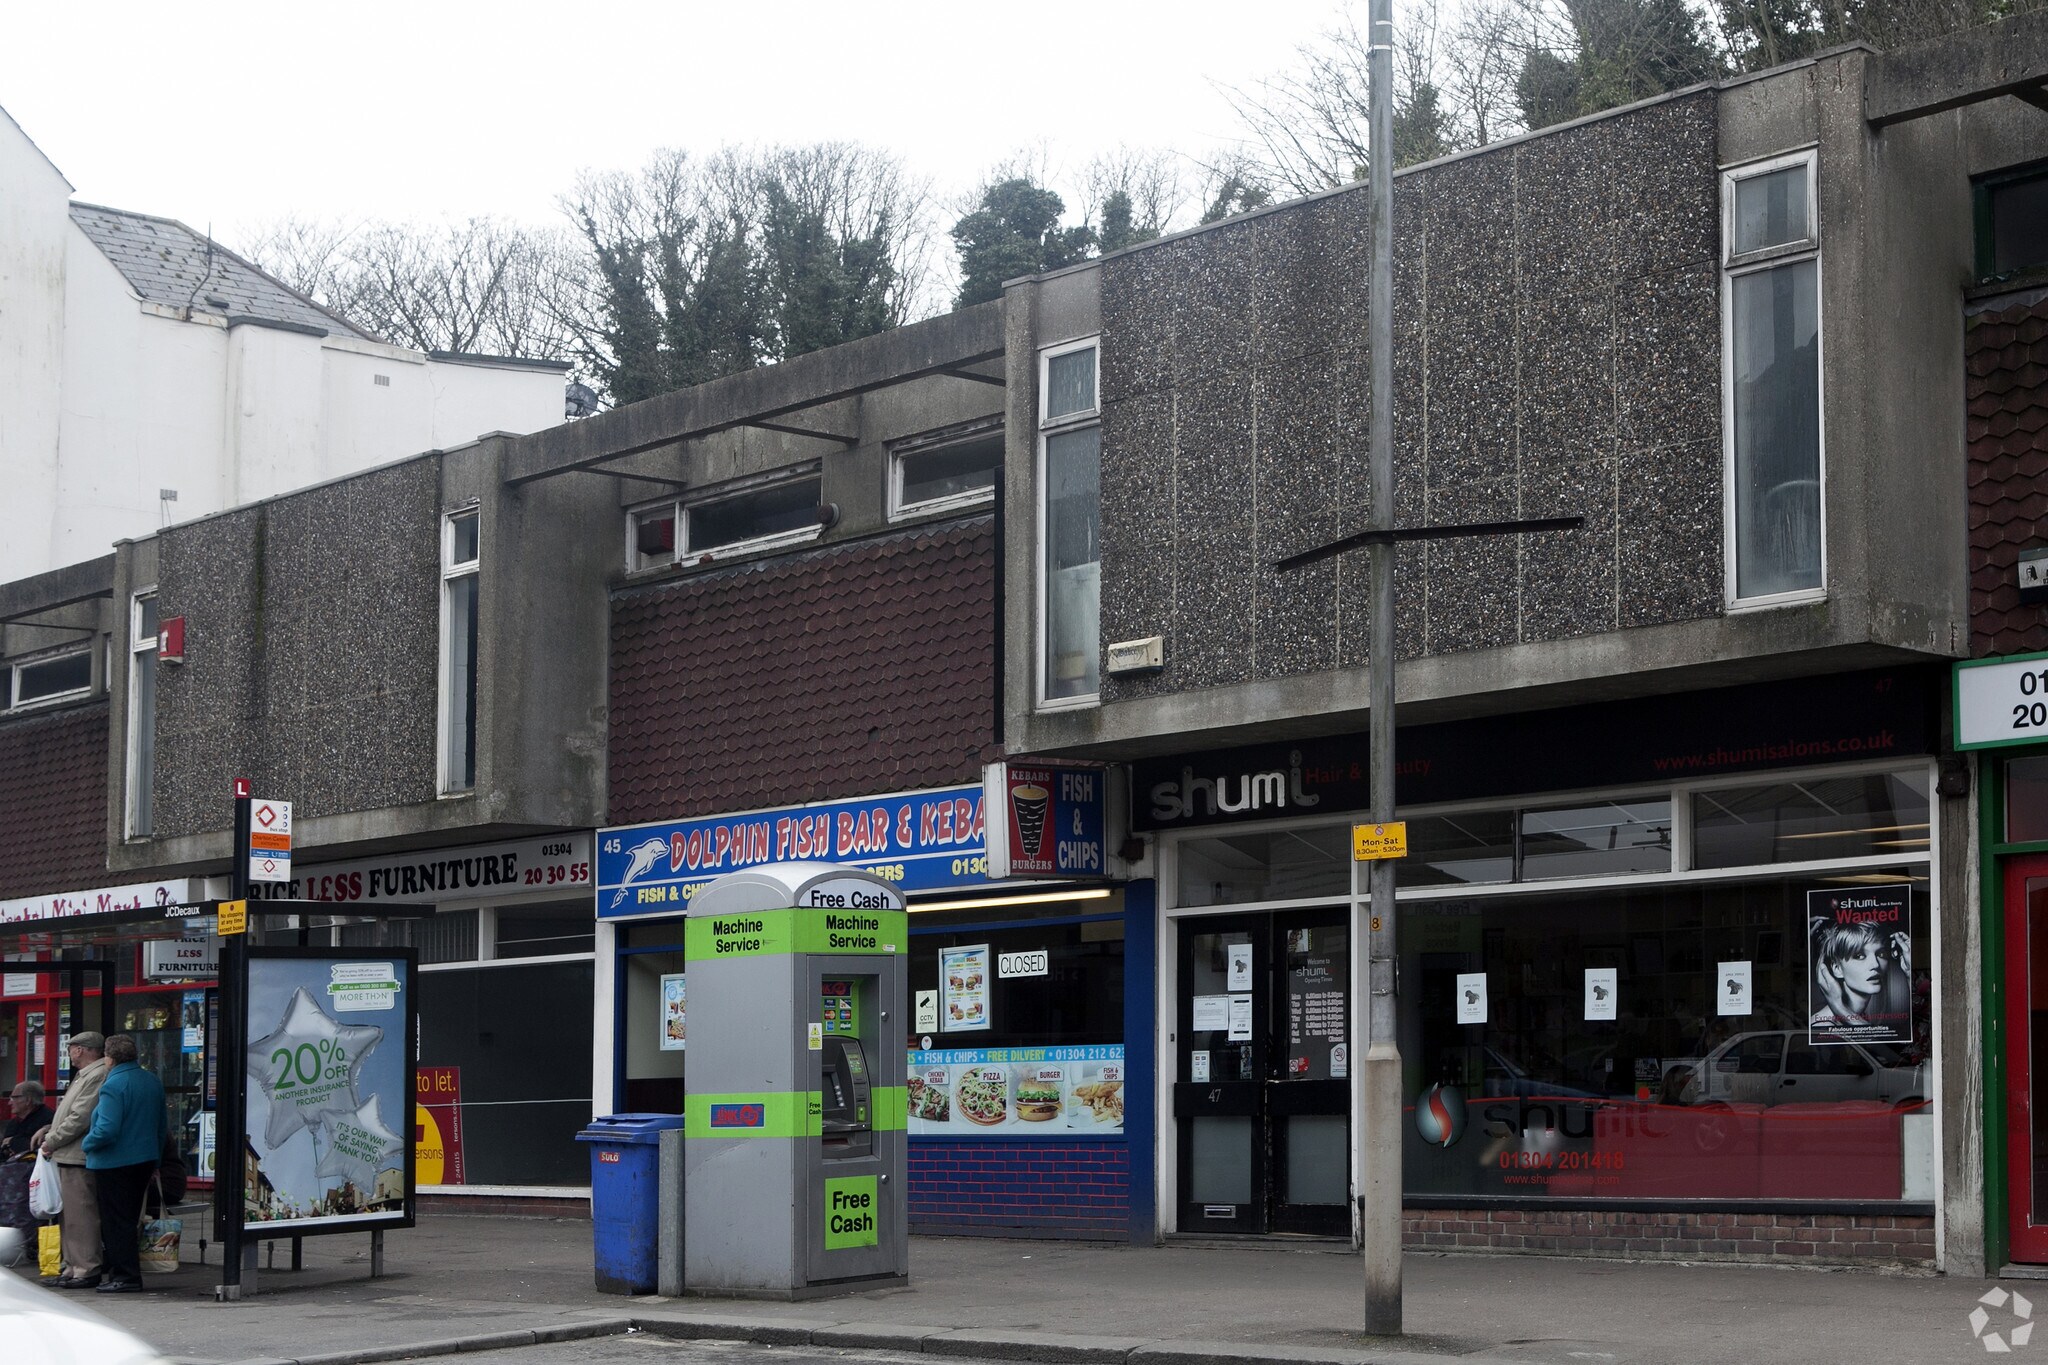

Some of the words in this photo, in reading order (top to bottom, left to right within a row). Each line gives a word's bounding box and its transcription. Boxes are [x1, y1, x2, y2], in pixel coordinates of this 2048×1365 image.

[2013, 702, 2047, 728] 20
[1653, 729, 1894, 770] www.shumisalons.co.uk
[1011, 770, 1050, 781] KEBABS
[1305, 764, 1343, 785] Hair
[1350, 764, 1361, 780] &
[237, 781, 247, 795] L
[1062, 773, 1093, 802] FISH
[1151, 749, 1320, 821] shumi
[1072, 807, 1083, 836] &
[604, 838, 622, 854] 45
[670, 821, 770, 873] DOLPHIN
[776, 812, 830, 862] FISH
[836, 807, 890, 857] BAR
[896, 803, 912, 849] &
[541, 842, 572, 857] 01304
[1058, 840, 1099, 869] CHIPS
[1012, 859, 1052, 870] BURGERS
[368, 853, 518, 898] FURNITURE
[524, 866, 543, 885] 20
[547, 864, 566, 884] 30
[570, 862, 589, 882] 55
[637, 886, 666, 904] FISH
[669, 885, 679, 901] &
[810, 889, 845, 908] Free
[851, 890, 889, 909] Cash
[1840, 896, 1880, 908] shumi
[165, 906, 200, 918] JCDecaux
[1835, 906, 1899, 924] Wanted
[713, 918, 763, 936] Machine
[826, 914, 879, 931] Machine
[1371, 917, 1380, 930] 8
[715, 937, 760, 953] Service
[829, 933, 876, 949] Service
[158, 963, 219, 971] FURNITURE
[1000, 954, 1046, 974] CLOSED
[339, 993, 363, 1001] MORE
[271, 1037, 345, 1091] 20%
[924, 1053, 944, 1064] FISH
[946, 1052, 951, 1063] &
[953, 1051, 977, 1063] CHIPS
[987, 1050, 1008, 1062] FREE
[1010, 1049, 1046, 1061] DILVERY
[1055, 1048, 1085, 1060] 01304
[1088, 1048, 1106, 1059] 212
[324, 1064, 348, 1081] OFF
[983, 1072, 1001, 1081] PIZZA
[1039, 1071, 1061, 1079] BURGER
[274, 1088, 309, 1101] ANOTHER
[309, 1080, 350, 1096] INSURANCE
[416, 1072, 430, 1092] to
[296, 1093, 331, 1107] PRODUCT
[1208, 1088, 1222, 1102] 47
[336, 1121, 350, 1133] IT'S
[351, 1126, 368, 1140] OUR
[369, 1133, 387, 1147] WAY
[338, 1132, 349, 1143] OF
[350, 1135, 379, 1154] SAYING
[333, 1140, 359, 1157] THANK
[360, 1150, 378, 1165] YOU
[416, 1147, 443, 1160] ersons
[1500, 1151, 1553, 1169] 01304
[1558, 1151, 1625, 1169] 201418
[832, 1190, 871, 1211] Free
[830, 1212, 873, 1234] Cash
